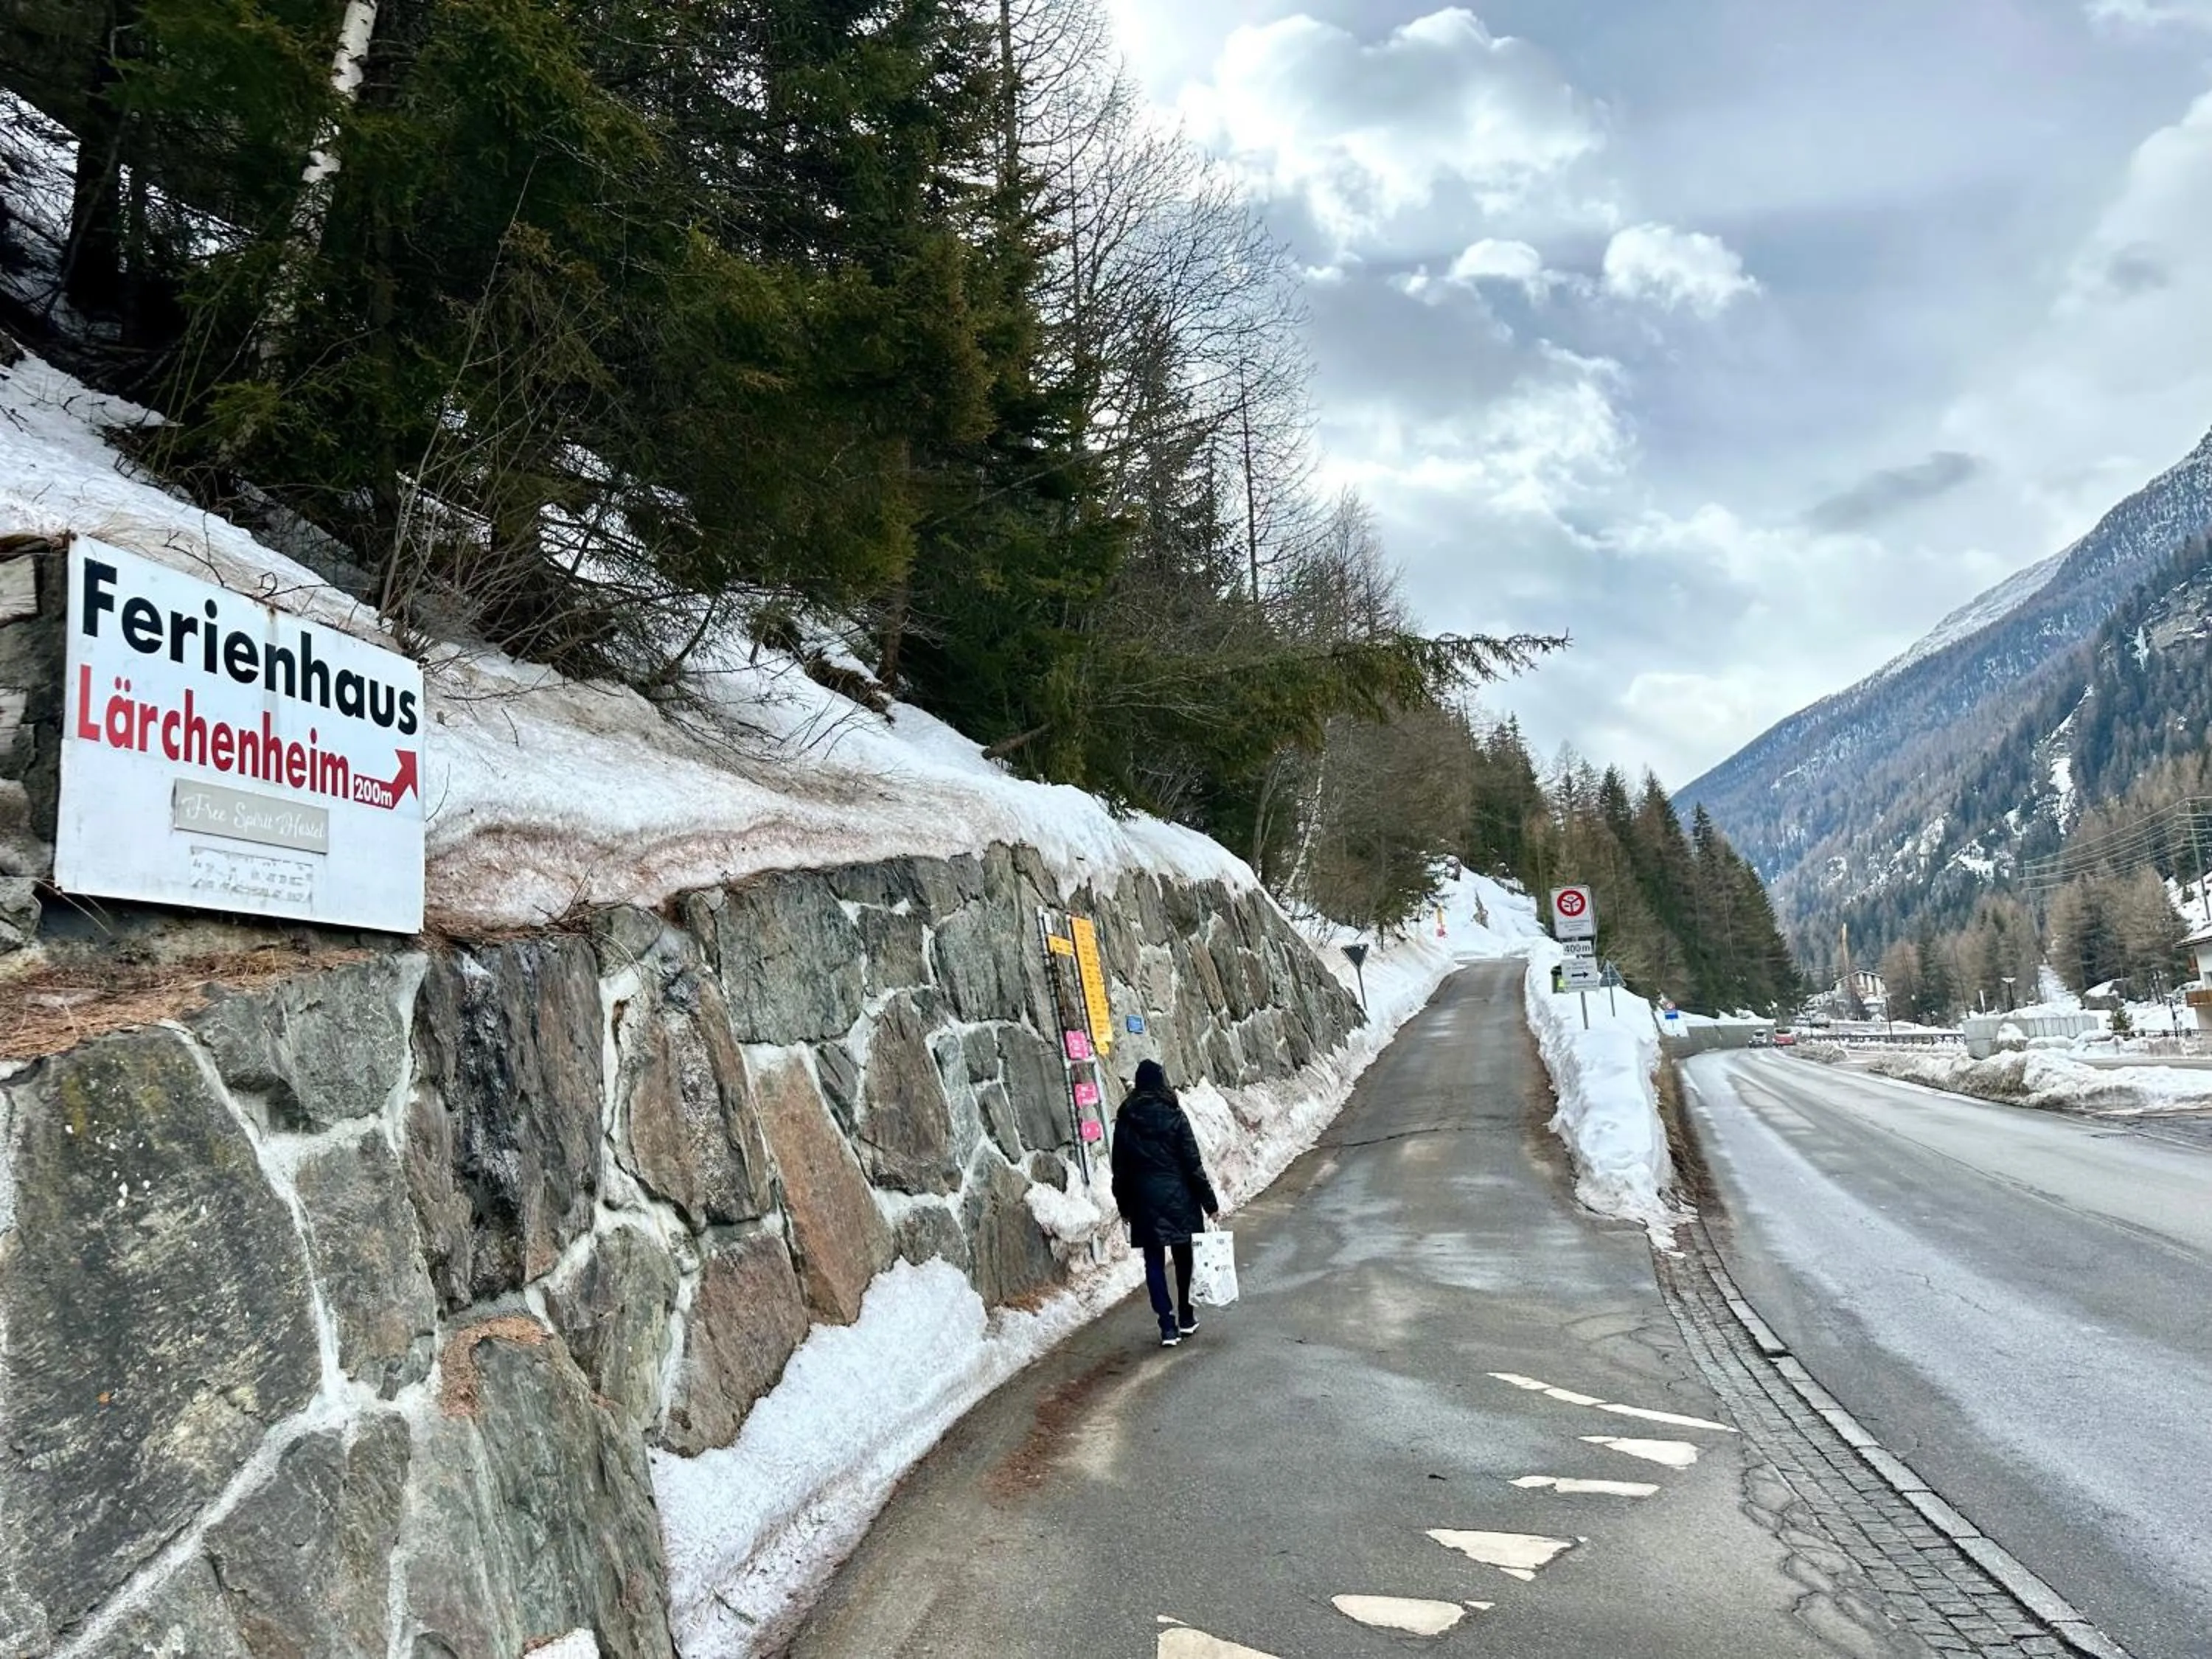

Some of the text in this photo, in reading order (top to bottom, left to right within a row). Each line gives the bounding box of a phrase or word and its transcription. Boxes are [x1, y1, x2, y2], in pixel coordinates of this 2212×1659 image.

[82, 557, 418, 736] Ferienhaus
[77, 664, 349, 800] Lärchenheim
[181, 793, 324, 838] Free Spirit Hostel
[355, 777, 393, 807] 200m
